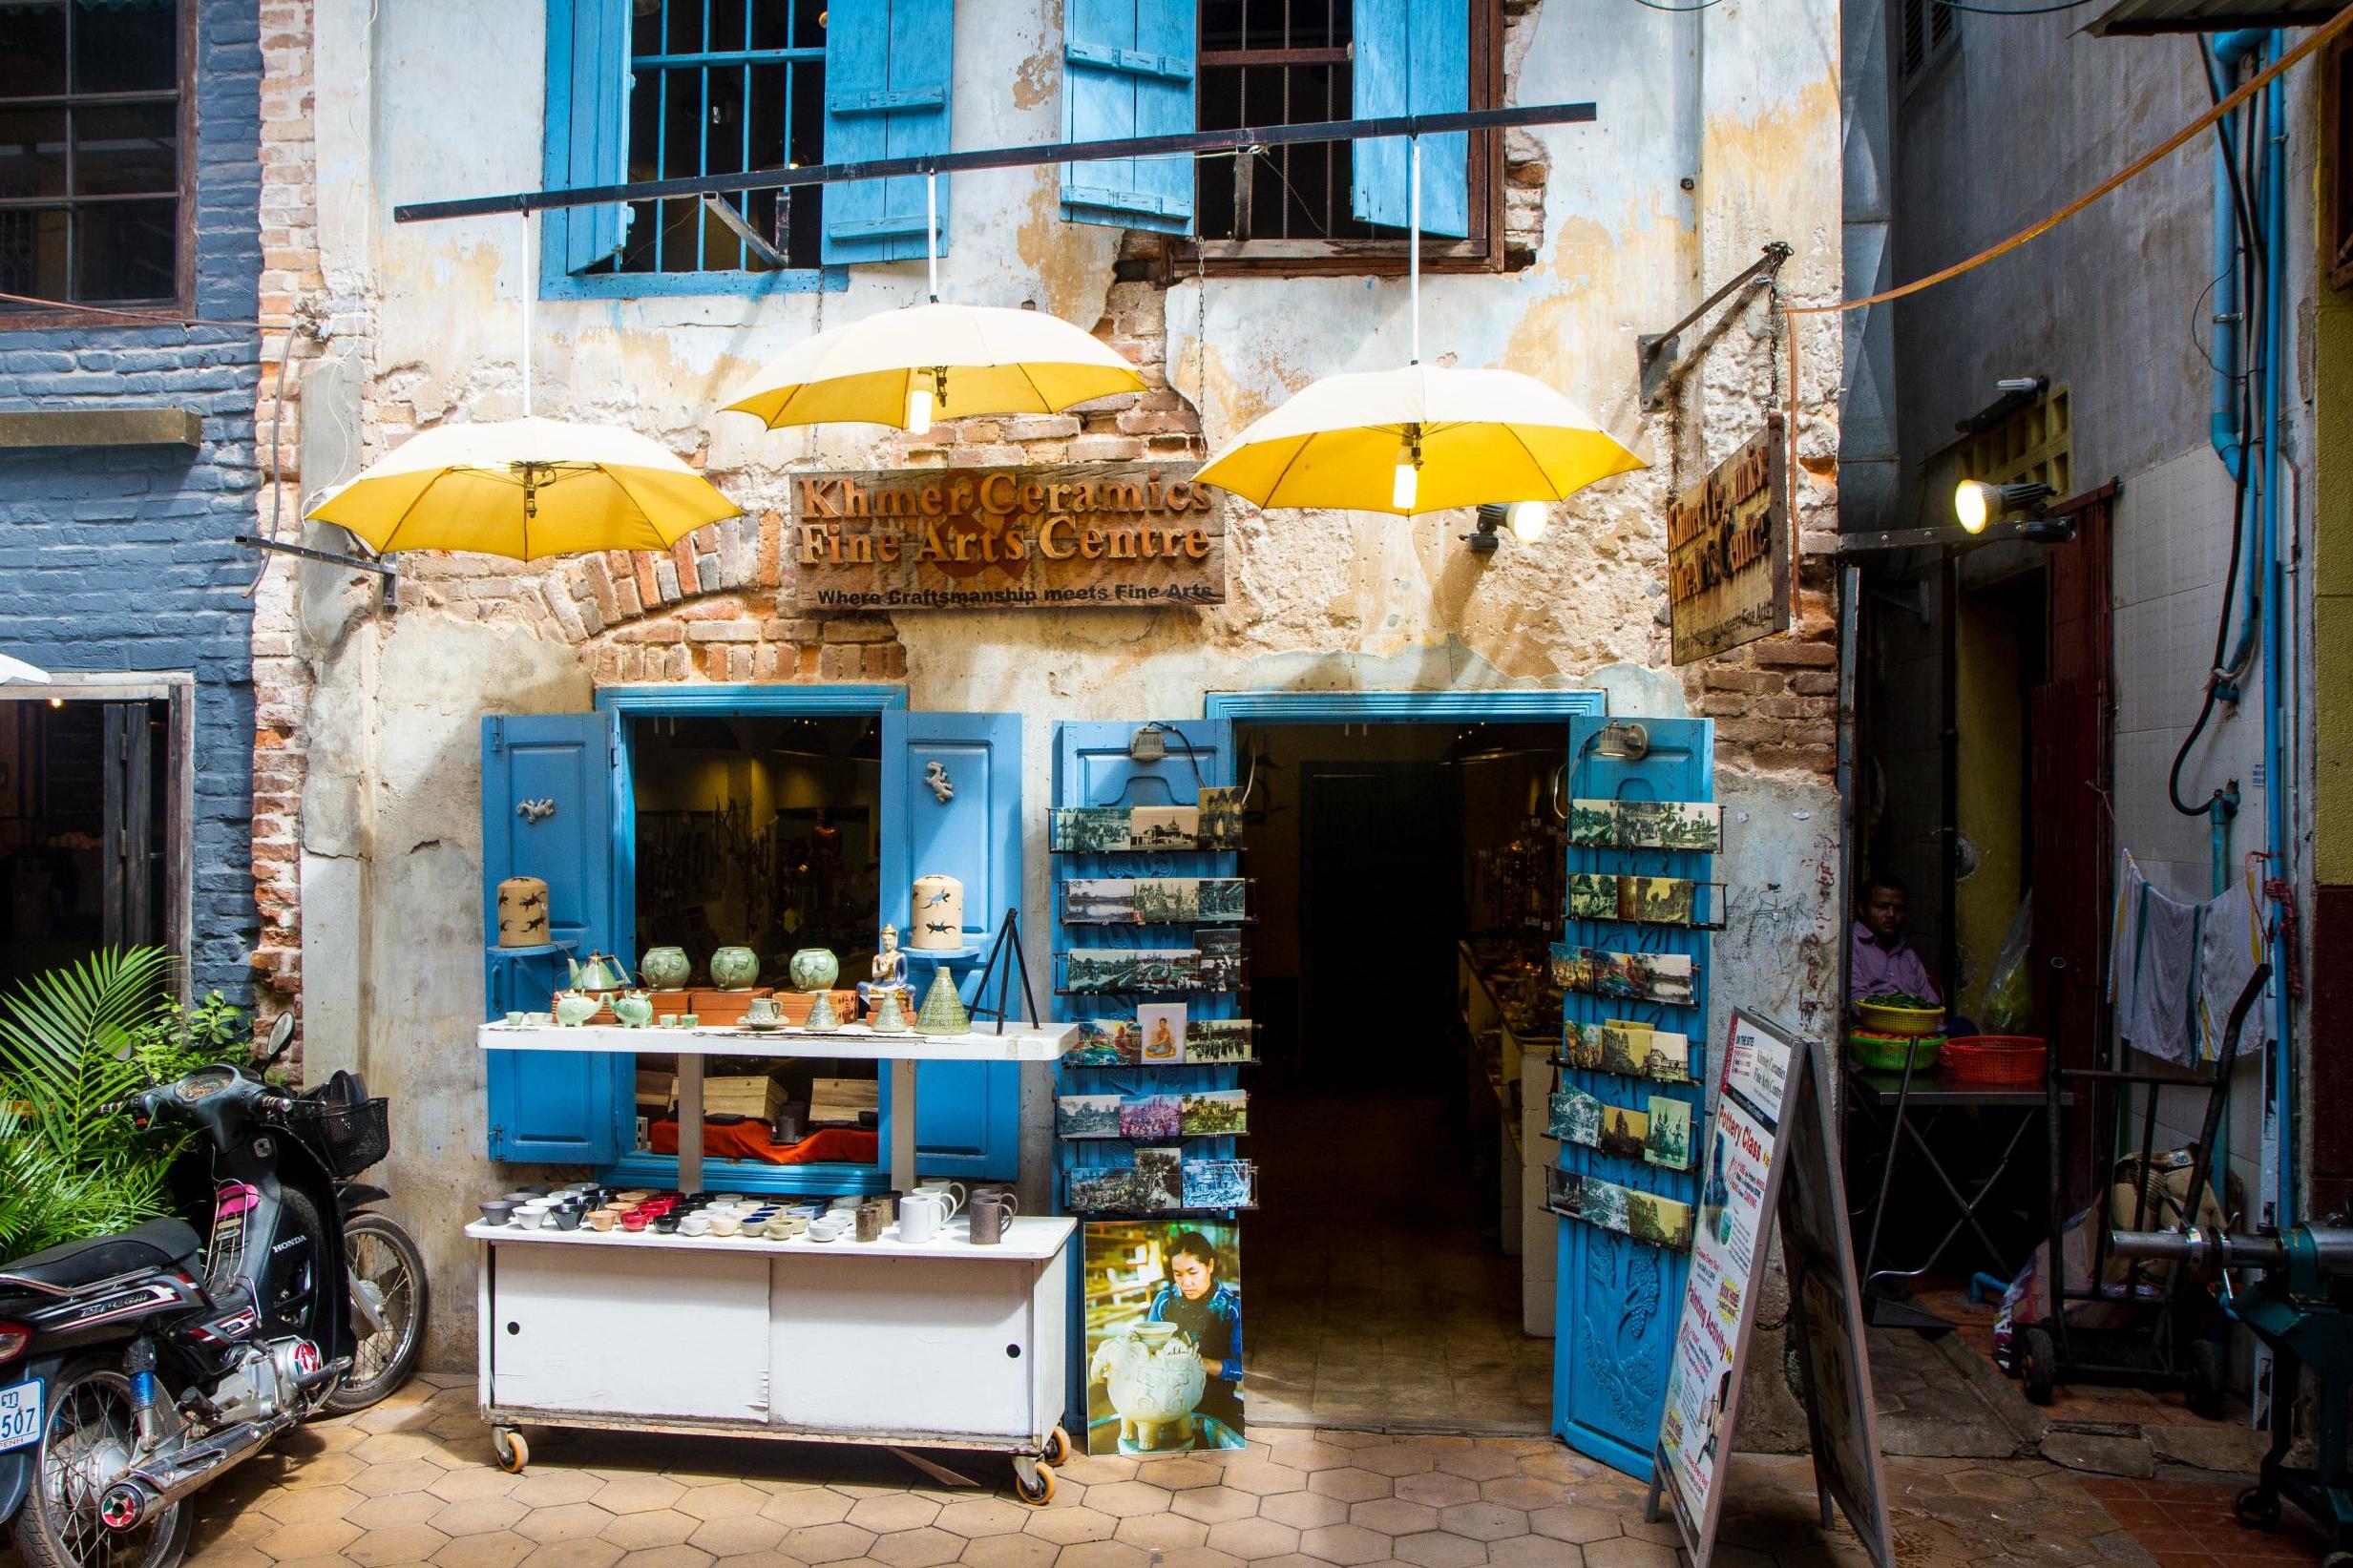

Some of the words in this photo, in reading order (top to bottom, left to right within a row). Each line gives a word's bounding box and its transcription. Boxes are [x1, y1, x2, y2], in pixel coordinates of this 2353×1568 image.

[798, 476, 973, 518] Khmer
[980, 469, 1213, 515] Ceramics
[798, 523, 900, 564] Fine
[915, 525, 1025, 563] Arts
[1039, 515, 1210, 560] Centre
[818, 589, 880, 605] Where
[887, 588, 1038, 608] Craftsmanship
[1043, 585, 1108, 602] meets
[1115, 583, 1163, 599] Fine
[1166, 583, 1214, 599] Arts
[1718, 1103, 1742, 1147] Pottery
[1742, 1126, 1762, 1162] Class
[272, 1235, 307, 1253] HONDA
[1688, 1279, 1707, 1329] Painting
[1706, 1311, 1727, 1362] Activity
[2, 1408, 35, 1438] 507
